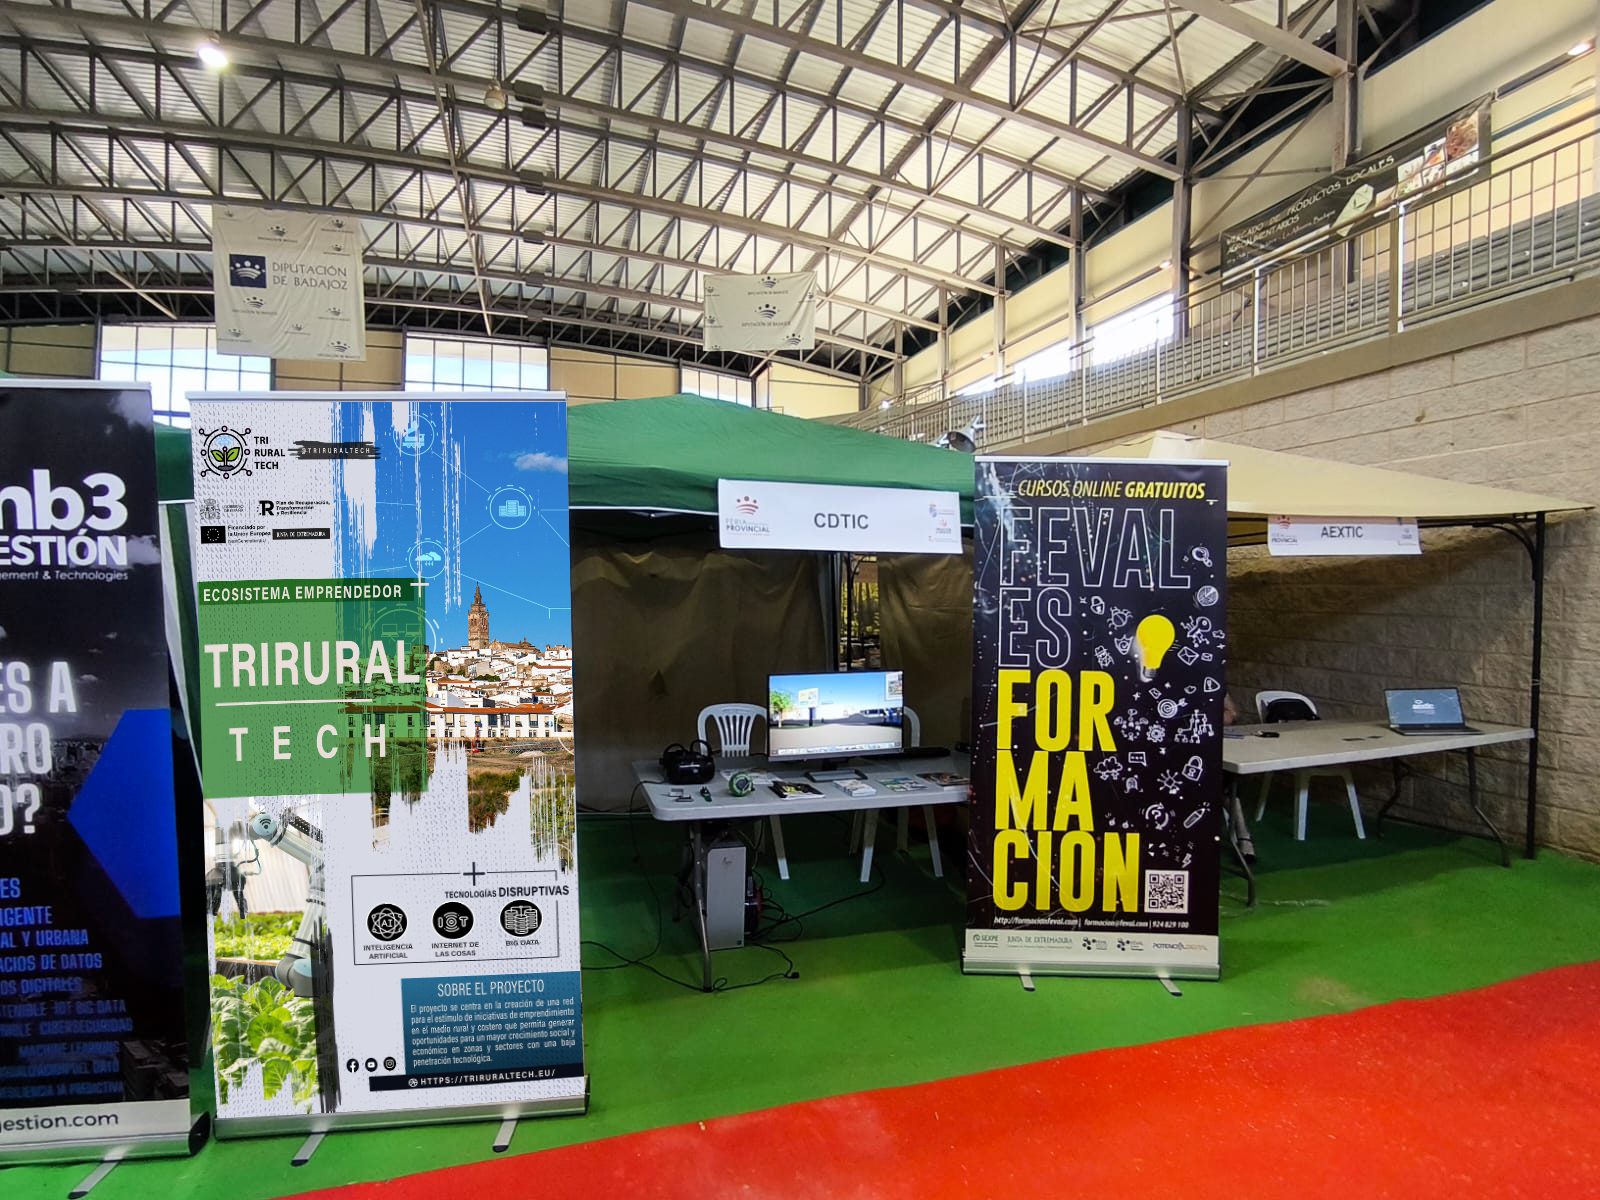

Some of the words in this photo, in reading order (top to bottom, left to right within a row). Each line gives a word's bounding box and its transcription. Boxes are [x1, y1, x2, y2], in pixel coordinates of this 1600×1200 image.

[1345, 154, 1395, 185] LOCALES
[272, 262, 347, 277] DIPUTACIÓN
[272, 275, 287, 286] DE
[294, 276, 348, 291] BADAJOZ
[254, 436, 269, 445] TRI
[254, 448, 286, 457] RURAL
[254, 461, 279, 470] TECH
[1018, 479, 1070, 497] CURSOS
[1072, 480, 1123, 498] ONLINE
[1125, 481, 1206, 499] GRATUITOS
[814, 512, 869, 530] CDTIC
[1321, 526, 1363, 539] AEXTIC
[1000, 507, 1191, 589] FEVAL
[0, 570, 38, 581] ement
[42, 571, 51, 580] &
[55, 570, 128, 582] Technologies
[203, 586, 290, 602] ECOSISTEMA
[295, 584, 402, 600] EMPRENDEDOR
[998, 586, 1072, 668] ES
[204, 640, 420, 688] TRIRURAL
[0, 661, 33, 714] S
[49, 661, 77, 713] A
[997, 668, 1117, 752] FOR
[994, 750, 1094, 832] MA
[992, 829, 1140, 913] CION
[444, 889, 497, 899] TECNOLOGÍAS
[498, 885, 569, 898] DISRUPTIVAS
[22, 931, 30, 947] Y
[36, 929, 89, 946] URBANA
[363, 943, 413, 951] INTELIGENCIA
[41, 954, 56, 970] DE
[61, 953, 103, 969] DATOS
[368, 952, 408, 960] ARTIFICIAL
[438, 982, 472, 997] SOBRE
[475, 982, 487, 996] EL
[490, 979, 544, 994] PROYECTO
[411, 1004, 416, 1013] El
[419, 1004, 447, 1014] proyecto
[505, 1000, 533, 1008] creación
[563, 997, 574, 1005] red
[411, 1016, 425, 1025] para
[427, 1015, 433, 1023] el
[465, 1013, 472, 1021] de
[474, 1011, 508, 1020] iniciativas
[510, 1010, 518, 1019] de
[520, 1008, 574, 1019] emprendimiento
[431, 1025, 450, 1033] medio
[453, 1024, 468, 1032] rural
[478, 1022, 502, 1031] costero
[520, 1020, 546, 1030] permita
[548, 1020, 574, 1029] generar
[412, 1036, 458, 1046] oportunidades
[487, 1033, 506, 1042] mayor
[508, 1030, 548, 1039] crecimiento
[550, 1028, 569, 1037] social
[412, 1046, 447, 1056] económico
[495, 1042, 523, 1051] sectores
[561, 1038, 575, 1048] baja
[414, 1056, 451, 1067] penetración
[420, 1069, 556, 1085] HTTPS://TRIRURALTECH.EU/
[0, 1113, 119, 1133] estion.com
